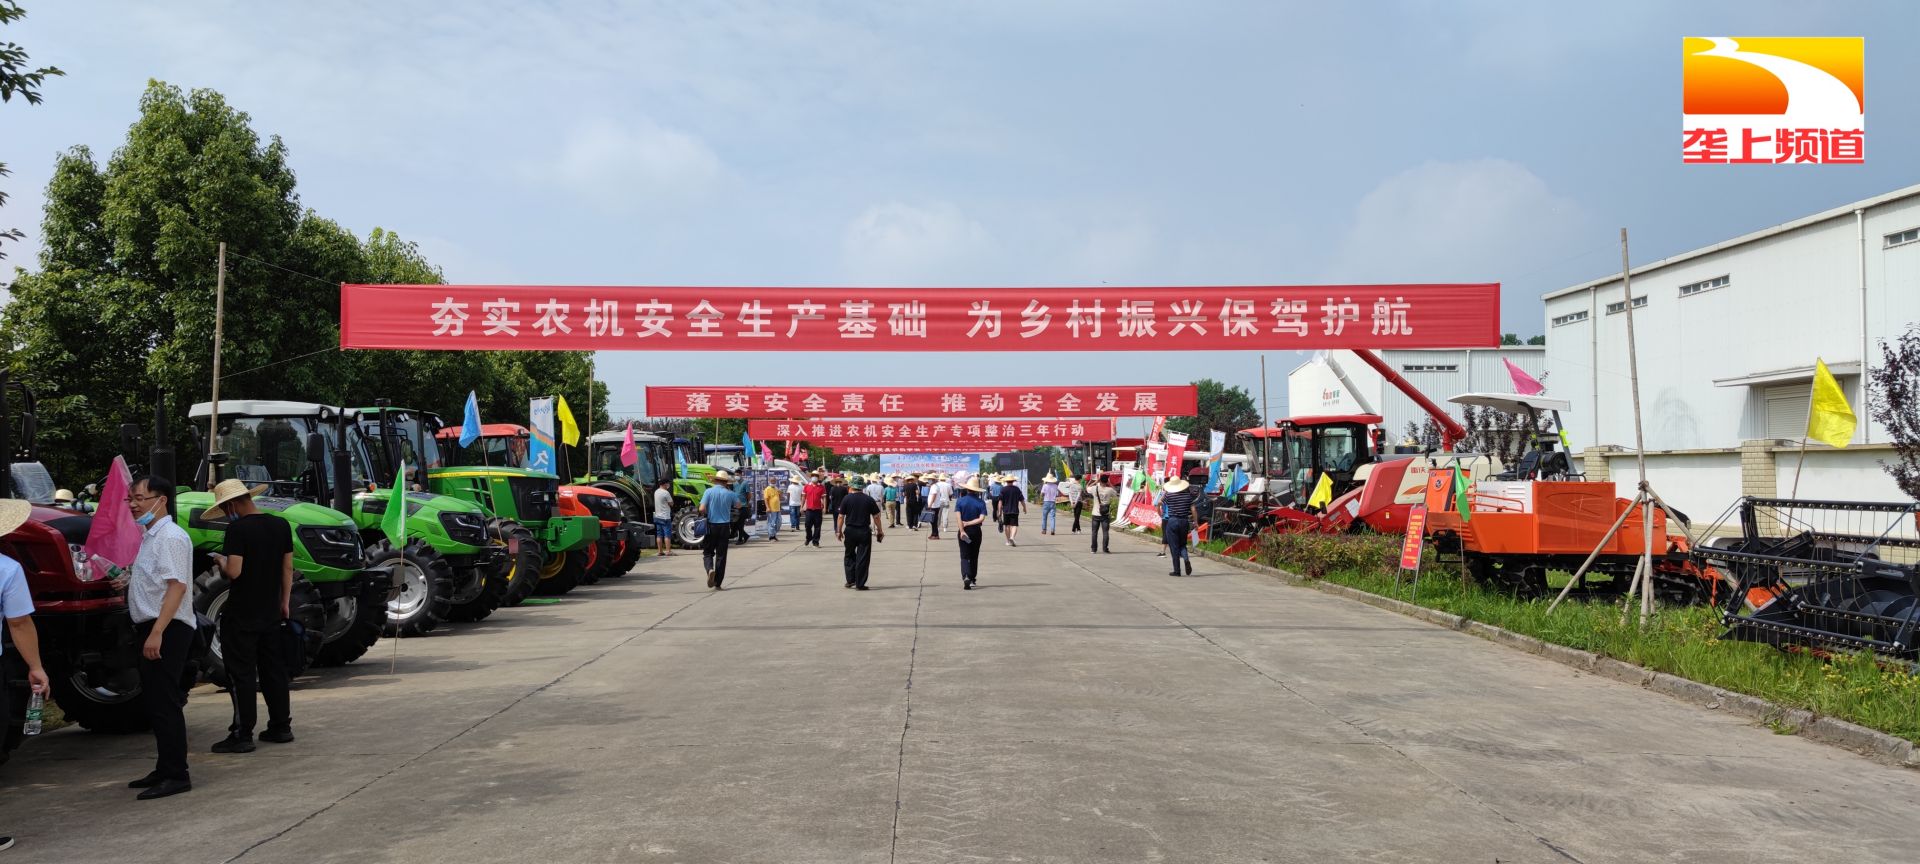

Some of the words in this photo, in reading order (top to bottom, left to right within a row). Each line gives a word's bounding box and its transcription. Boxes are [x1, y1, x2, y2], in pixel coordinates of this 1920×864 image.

[430, 297, 928, 339] 夯实农机安全生产基础
[966, 296, 1413, 338] 为乡村振兴保驾护航
[686, 393, 905, 413] 落实安全责任
[941, 392, 1158, 413] 推动安全发展
[777, 423, 1084, 438] 深入推进农机安全生产专项整治三年行动
